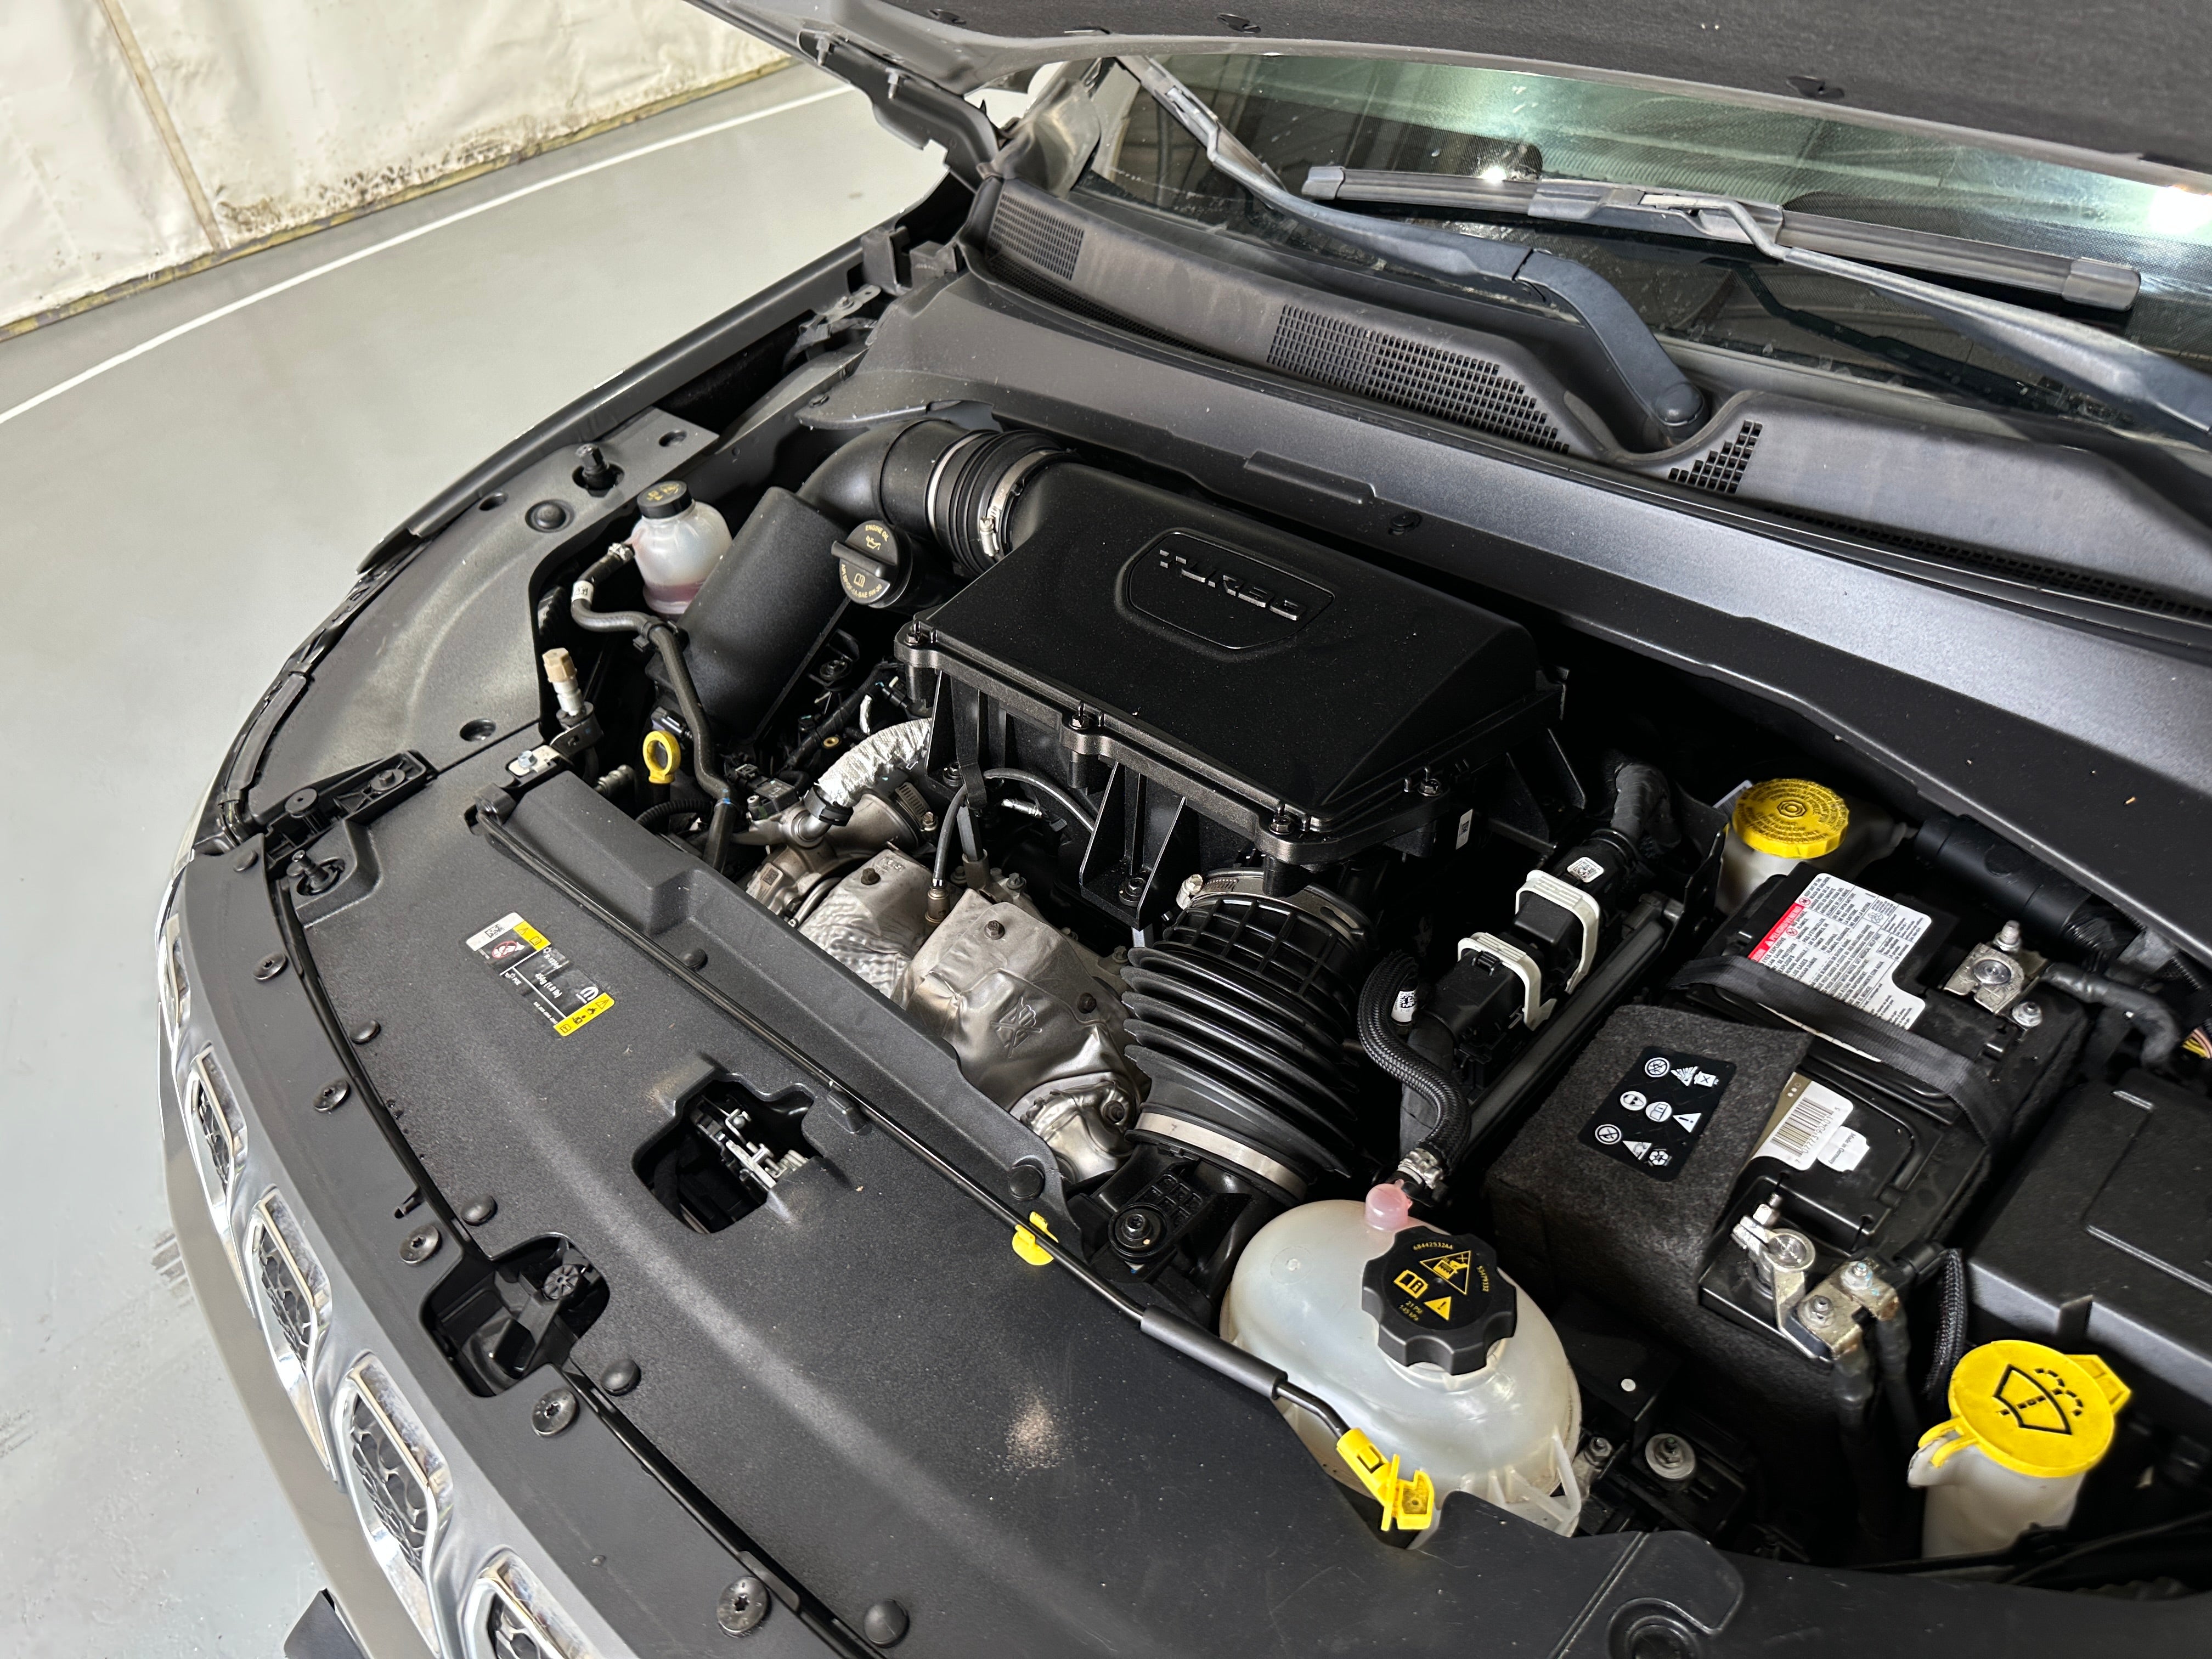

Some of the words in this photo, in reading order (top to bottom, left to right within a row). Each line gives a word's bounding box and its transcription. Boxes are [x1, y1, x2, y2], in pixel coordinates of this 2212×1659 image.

[865, 524, 883, 534] ENGINE
[1844, 1132, 1857, 1144] Made
[1828, 1148, 1845, 1165] Germany
